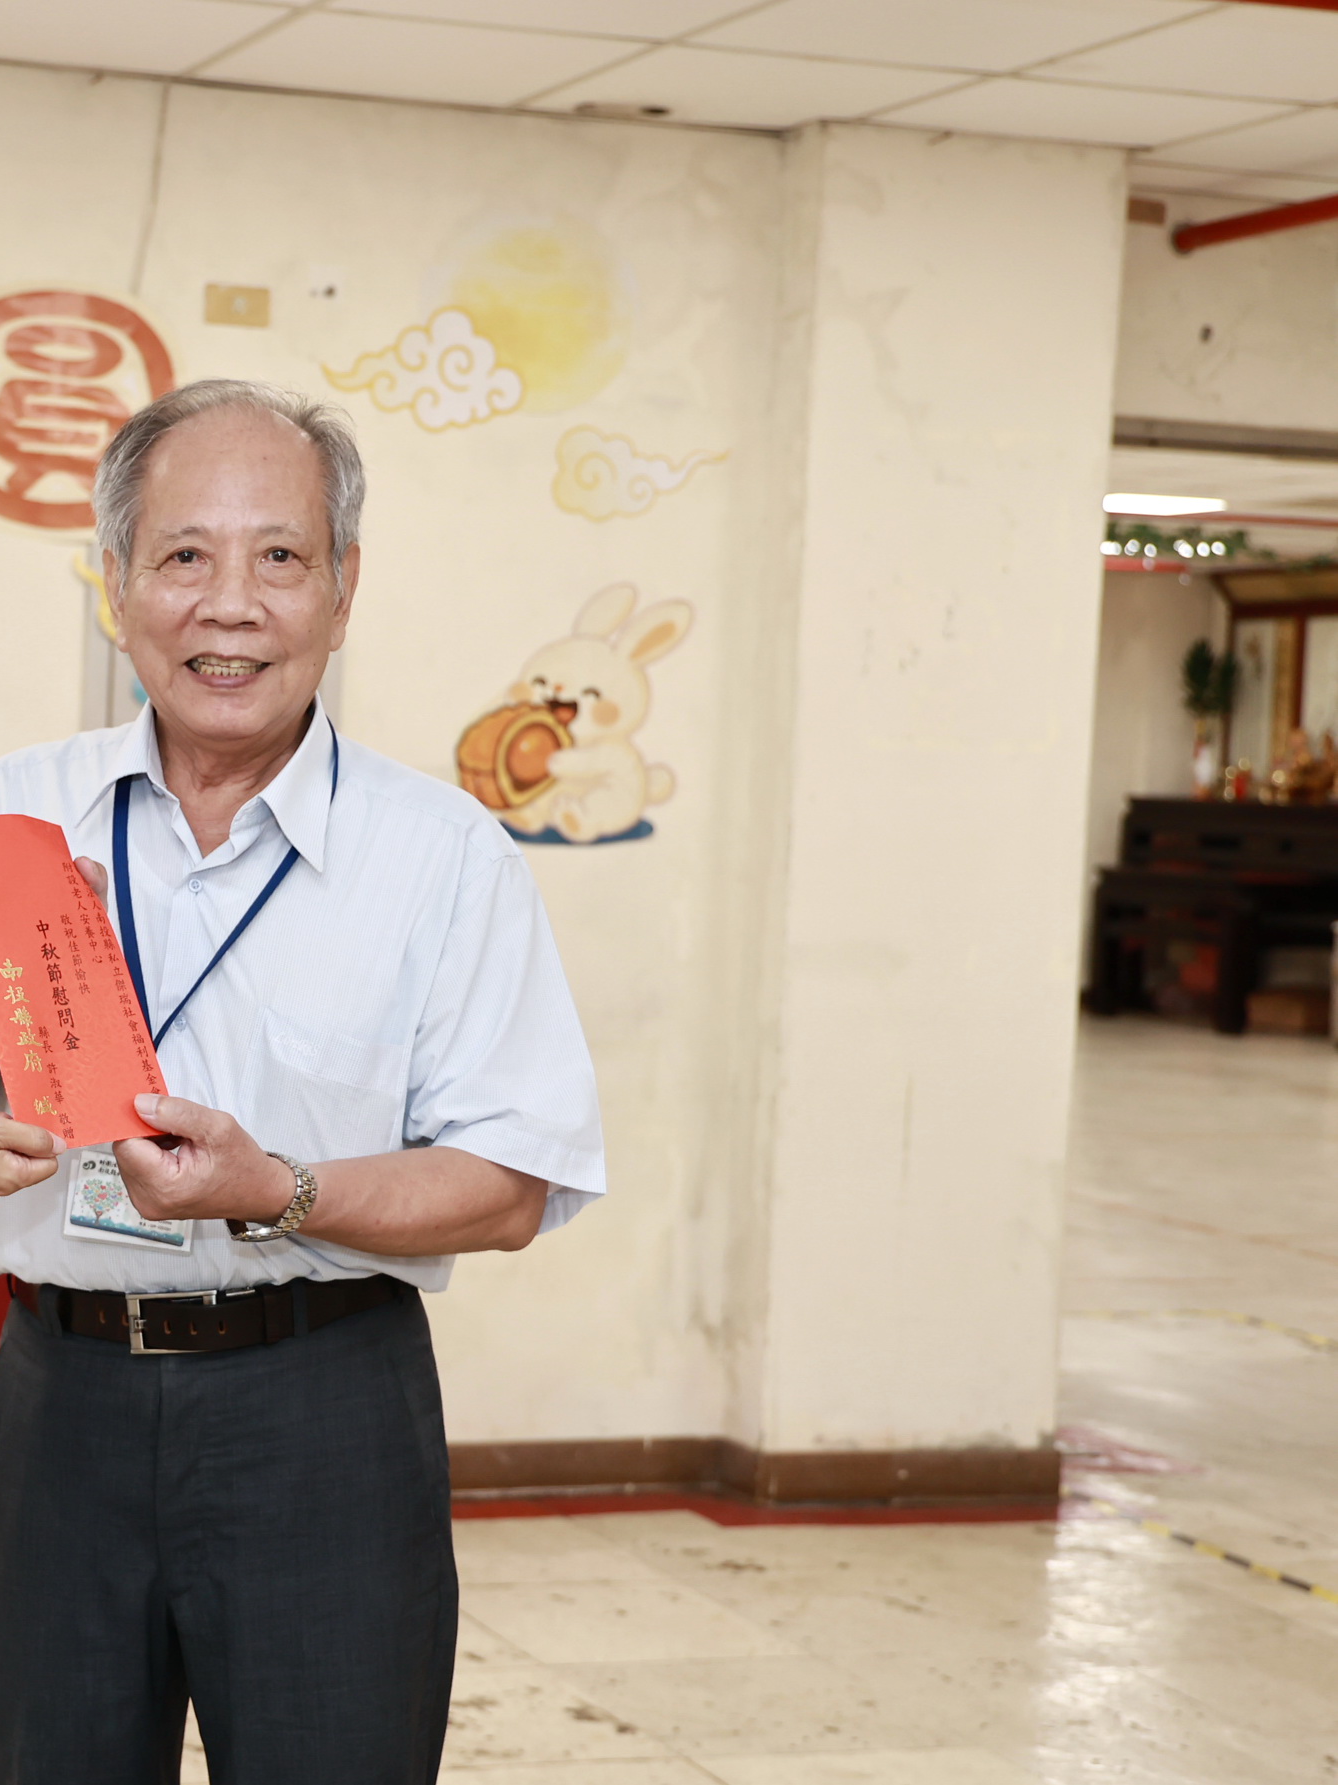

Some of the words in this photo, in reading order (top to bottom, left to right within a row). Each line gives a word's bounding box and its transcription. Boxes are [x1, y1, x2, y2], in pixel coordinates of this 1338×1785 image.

[60, 913, 91, 995] 敬祝佳節愉快
[62, 862, 103, 965] 附設老人安養中心
[35, 919, 81, 1052] 中秋節慰問金
[38, 1025, 54, 1054] 縣長
[46, 1062, 65, 1105] 許淑華
[59, 1112, 76, 1140] 敬贈
